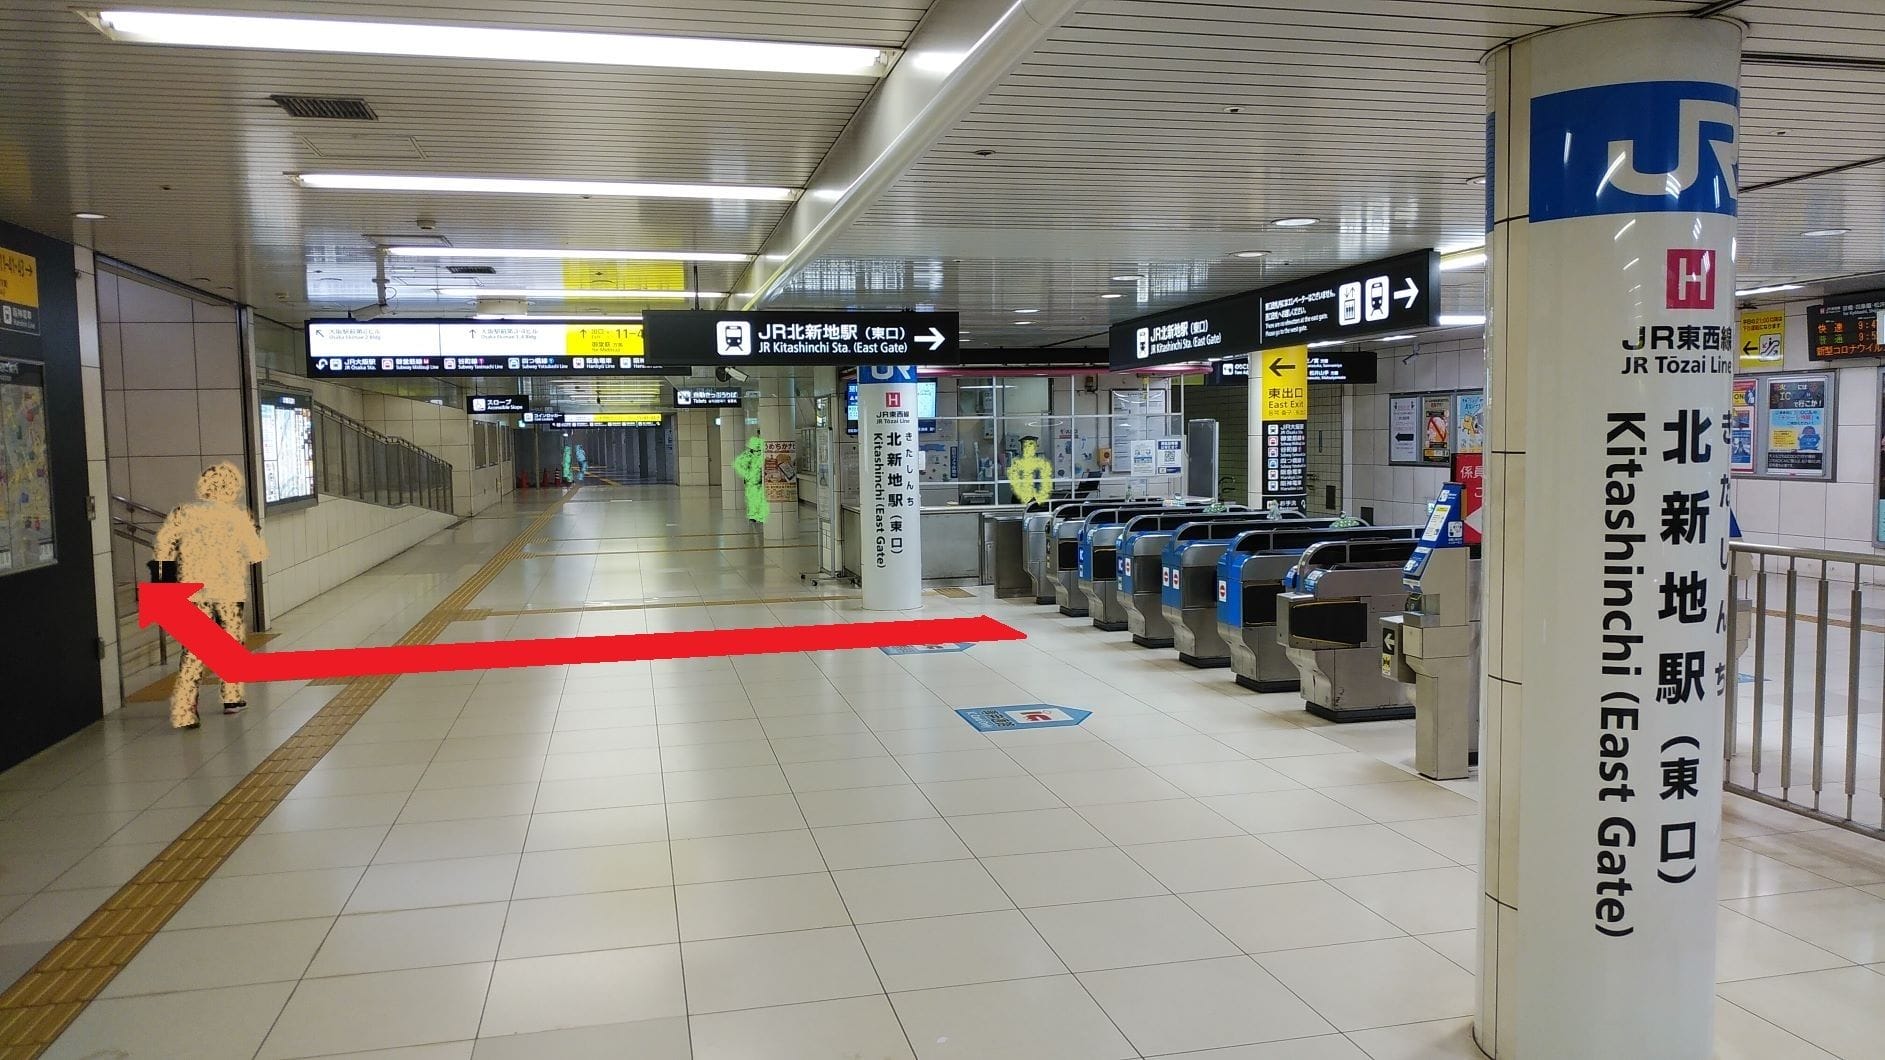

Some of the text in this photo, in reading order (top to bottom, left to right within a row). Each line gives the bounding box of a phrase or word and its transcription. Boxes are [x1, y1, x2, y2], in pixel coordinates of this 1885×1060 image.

[758, 323, 906, 341] JR北新地駅（東口）
[1622, 325, 1732, 351] JR東西線
[758, 341, 908, 354] JR Kitashinchi Sta. (East Gate)
[1816, 342, 1885, 356] 新型コロナウイル
[1622, 357, 1648, 375] JR
[1711, 356, 1732, 374] Line
[1268, 387, 1303, 399] 東出口
[1269, 400, 1304, 409] East Exit
[905, 431, 914, 507] きたしんち
[1461, 465, 1487, 480] 係員
[873, 432, 887, 569] Kitashinchi (East Gate)
[886, 431, 904, 554] 北新地駅（東口）
[1655, 408, 1712, 884] 北新地駅（東口）
[1595, 412, 1647, 938] Kitashinchi (East Gate)
